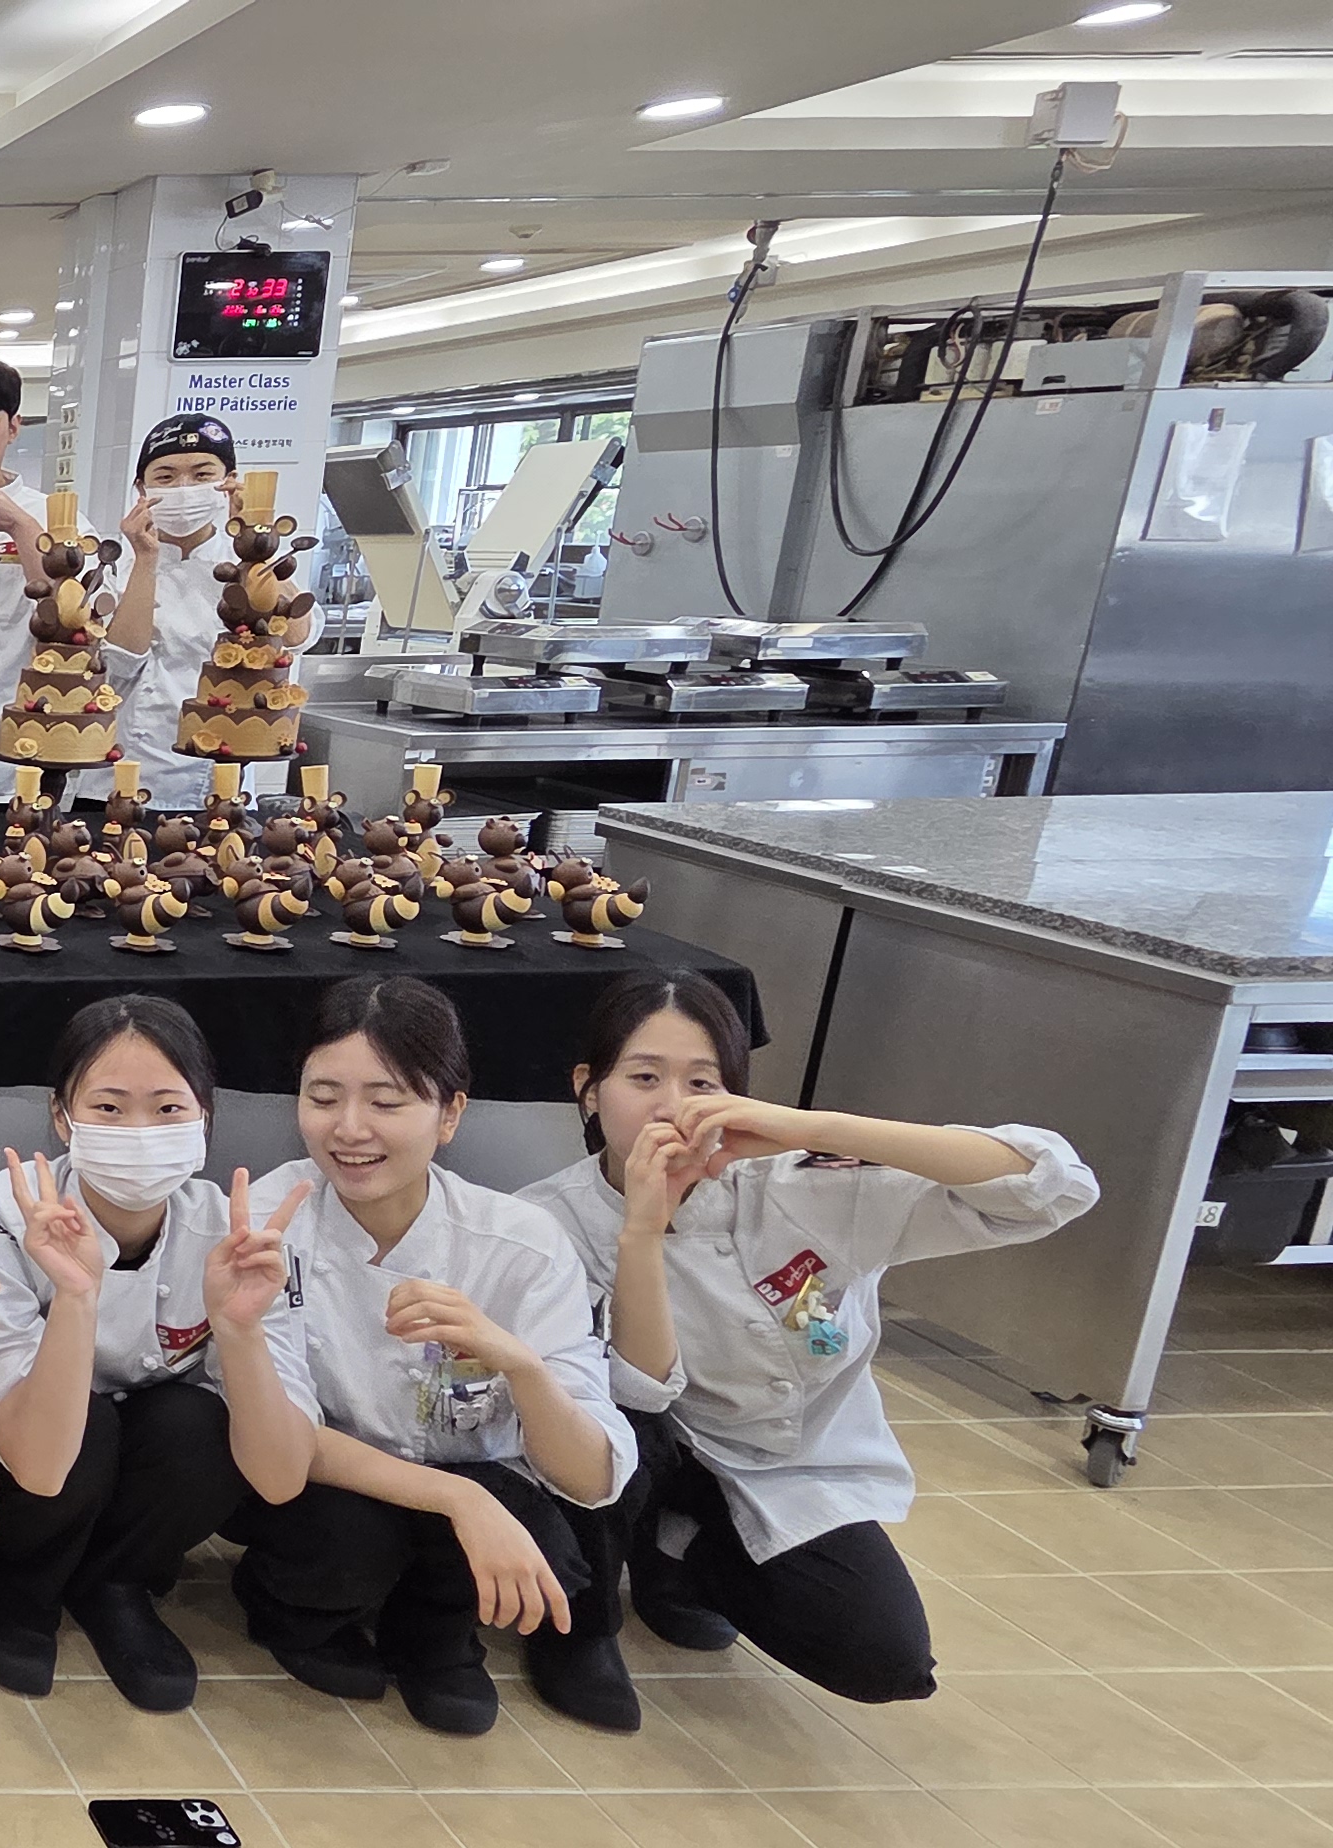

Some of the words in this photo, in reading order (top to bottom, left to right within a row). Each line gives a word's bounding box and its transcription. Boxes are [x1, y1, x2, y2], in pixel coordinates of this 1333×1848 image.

[189, 374, 244, 389] Master
[248, 373, 290, 389] Class
[177, 396, 216, 412] INBP
[219, 395, 298, 412] Pâtisserie
